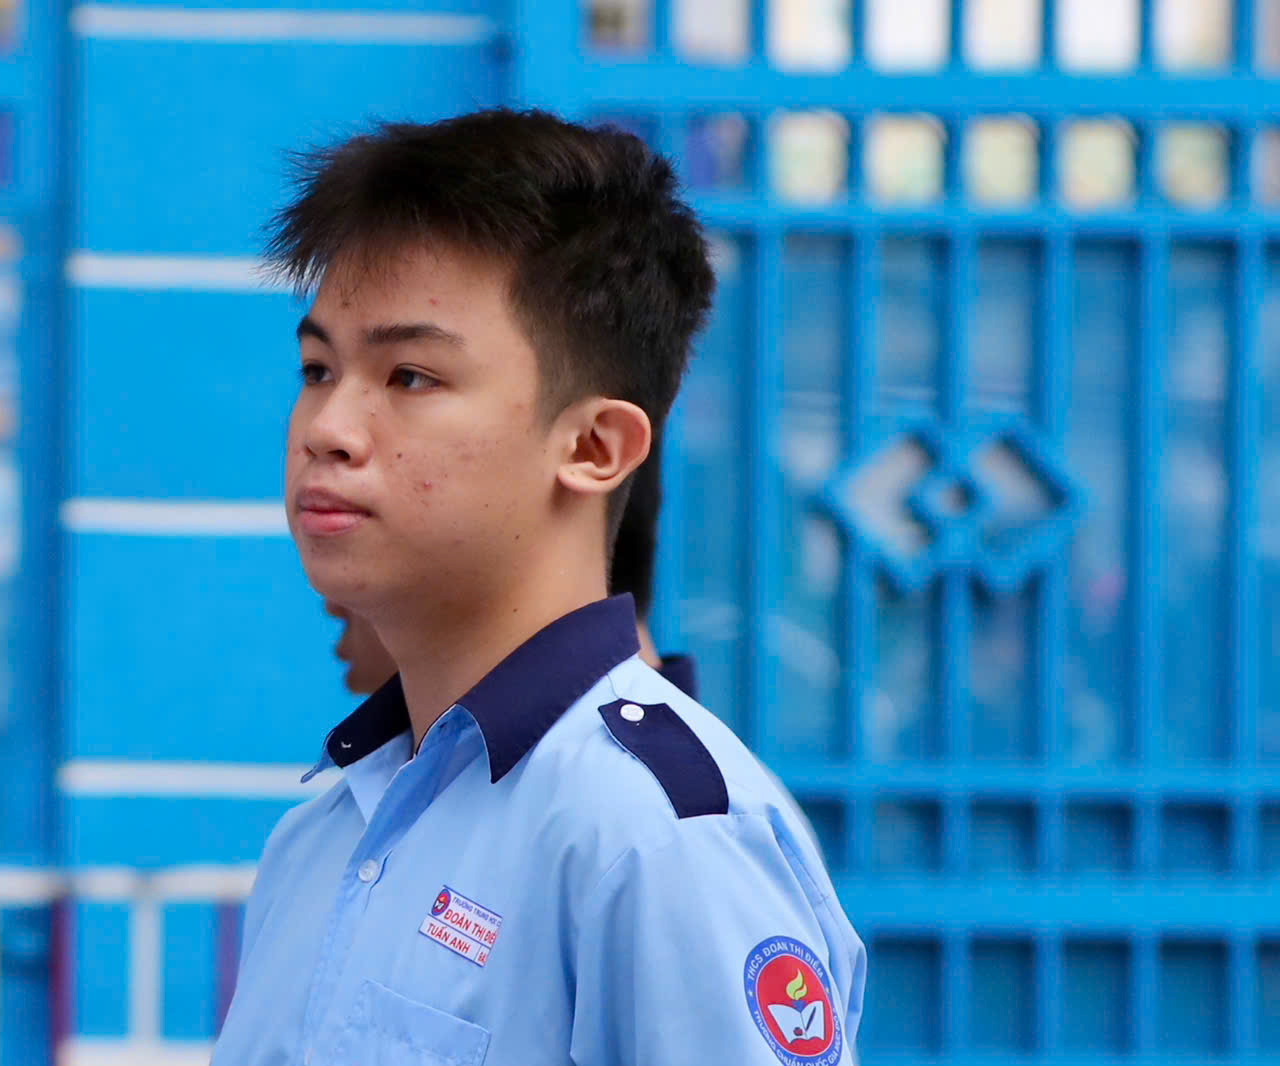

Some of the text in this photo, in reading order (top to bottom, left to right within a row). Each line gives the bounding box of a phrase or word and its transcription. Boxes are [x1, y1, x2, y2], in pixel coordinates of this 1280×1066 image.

[444, 909, 472, 931] ĐOÀN
[450, 937, 472, 954] ANH
[747, 954, 763, 981] THCS
[763, 939, 788, 957] ĐOÀN
